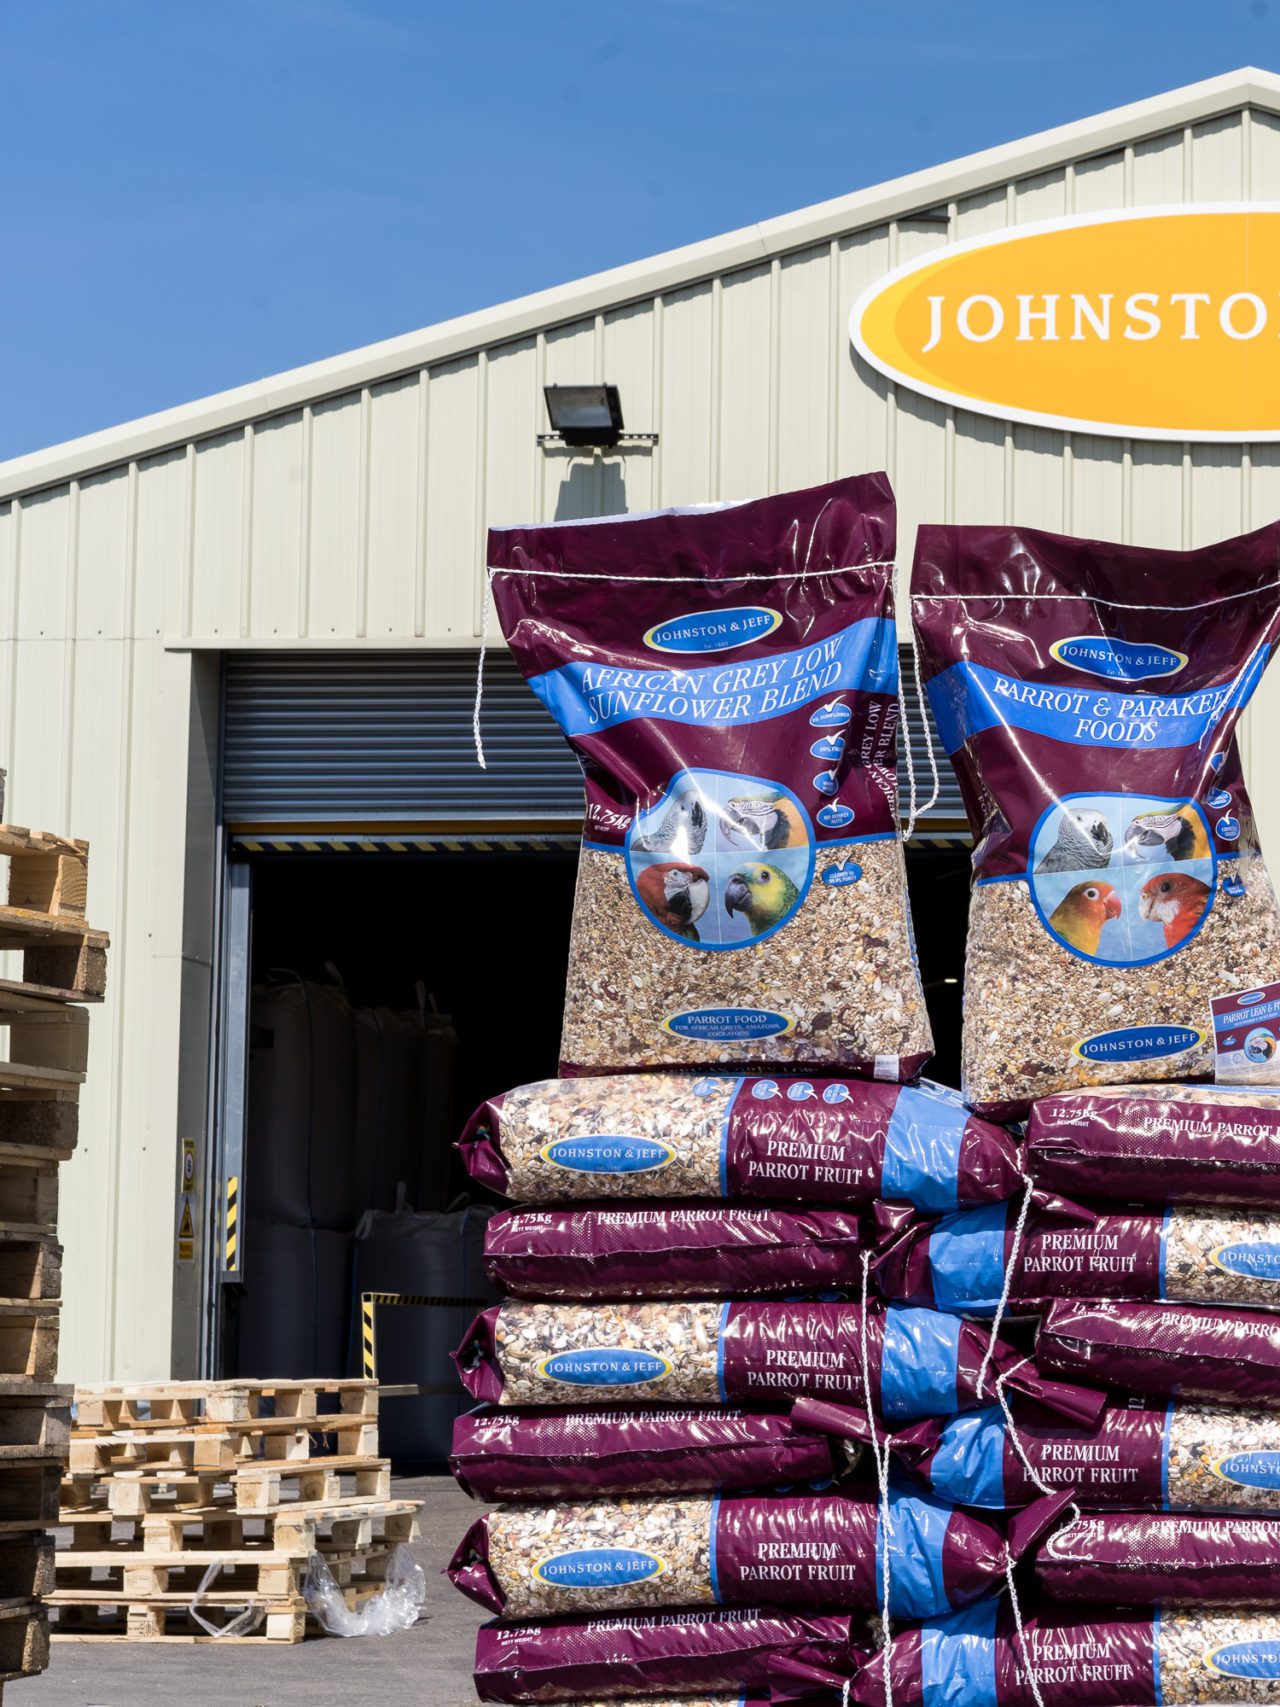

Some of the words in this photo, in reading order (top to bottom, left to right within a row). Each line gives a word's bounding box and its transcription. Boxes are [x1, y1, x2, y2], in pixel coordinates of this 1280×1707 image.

[656, 623, 727, 644] JOHNSTON
[730, 621, 740, 632] &
[742, 614, 771, 631] JEFF
[1062, 645, 1132, 665] JOHNSTON
[1135, 656, 1144, 666] &
[1147, 655, 1177, 666] JEFF
[581, 667, 707, 696] AFRICAN
[712, 659, 788, 695] GREY
[790, 634, 845, 679] LOW
[588, 690, 752, 724] SUNFLOWER
[758, 661, 842, 714] BLEND
[993, 676, 1089, 715] PARROT
[1092, 697, 1112, 718] &
[865, 700, 882, 730] LOW
[878, 703, 899, 746] BLEND
[1073, 718, 1158, 742] FOODS
[862, 733, 874, 768] GREY
[588, 803, 632, 830] 12.75Kg
[688, 1016, 732, 1024] PARROT
[734, 1014, 767, 1024] FOOD
[1222, 1009, 1250, 1024] PARROT
[1250, 1006, 1266, 1018] LEAN
[1083, 1038, 1153, 1055] JOHNSTON
[1156, 1036, 1166, 1046] &
[1168, 1032, 1196, 1046] JEFF
[1052, 1108, 1098, 1120] 12.75Kg
[1144, 1117, 1214, 1133] PREMIUM
[1216, 1122, 1272, 1137] PARROT
[552, 1147, 621, 1159] JOHNSTON
[624, 1148, 634, 1158] &
[636, 1148, 665, 1160] JEFF
[766, 1140, 846, 1162] PREMIUM
[748, 1160, 810, 1180] PARROT
[814, 1166, 862, 1184] FRUIT
[597, 1212, 666, 1225] PREMIUM
[670, 1210, 724, 1222] PARROT
[728, 1209, 771, 1221] FRUIT
[1041, 1234, 1119, 1250] PREMIUM
[1024, 1256, 1084, 1272] PARROT
[1088, 1256, 1137, 1272] FRUIT
[1160, 1312, 1230, 1331] PREMIUM
[548, 1362, 618, 1373] JOHNSTON
[621, 1362, 631, 1372] &
[634, 1362, 662, 1372] JEFF
[766, 1350, 845, 1368] PREMIUM
[747, 1372, 810, 1388] PARROT
[814, 1374, 862, 1390] FRUIT
[474, 1415, 520, 1426] 12.75Kg
[566, 1412, 634, 1426] PREMIUM
[640, 1410, 696, 1422] PARROT
[698, 1410, 741, 1422] FRUIT
[1040, 1444, 1120, 1462] PREMIUM
[1090, 1468, 1138, 1483] FRUIT
[1151, 1520, 1220, 1534] PREMIUM
[1226, 1520, 1280, 1534] PARROT
[758, 1542, 837, 1560] PREMIUM
[544, 1562, 612, 1576] JOHNSTON
[614, 1562, 624, 1572] &
[626, 1560, 656, 1572] JEFF
[740, 1564, 802, 1580] PARROT
[808, 1564, 856, 1580] FRUIT
[586, 1616, 656, 1633] PREMIUM
[660, 1612, 715, 1628] PARROT
[720, 1608, 760, 1622] FRUIT
[496, 1626, 542, 1640] 12.75Kg
[1032, 1642, 1111, 1662] PREMIUM
[1082, 1664, 1130, 1682] FRUIT
